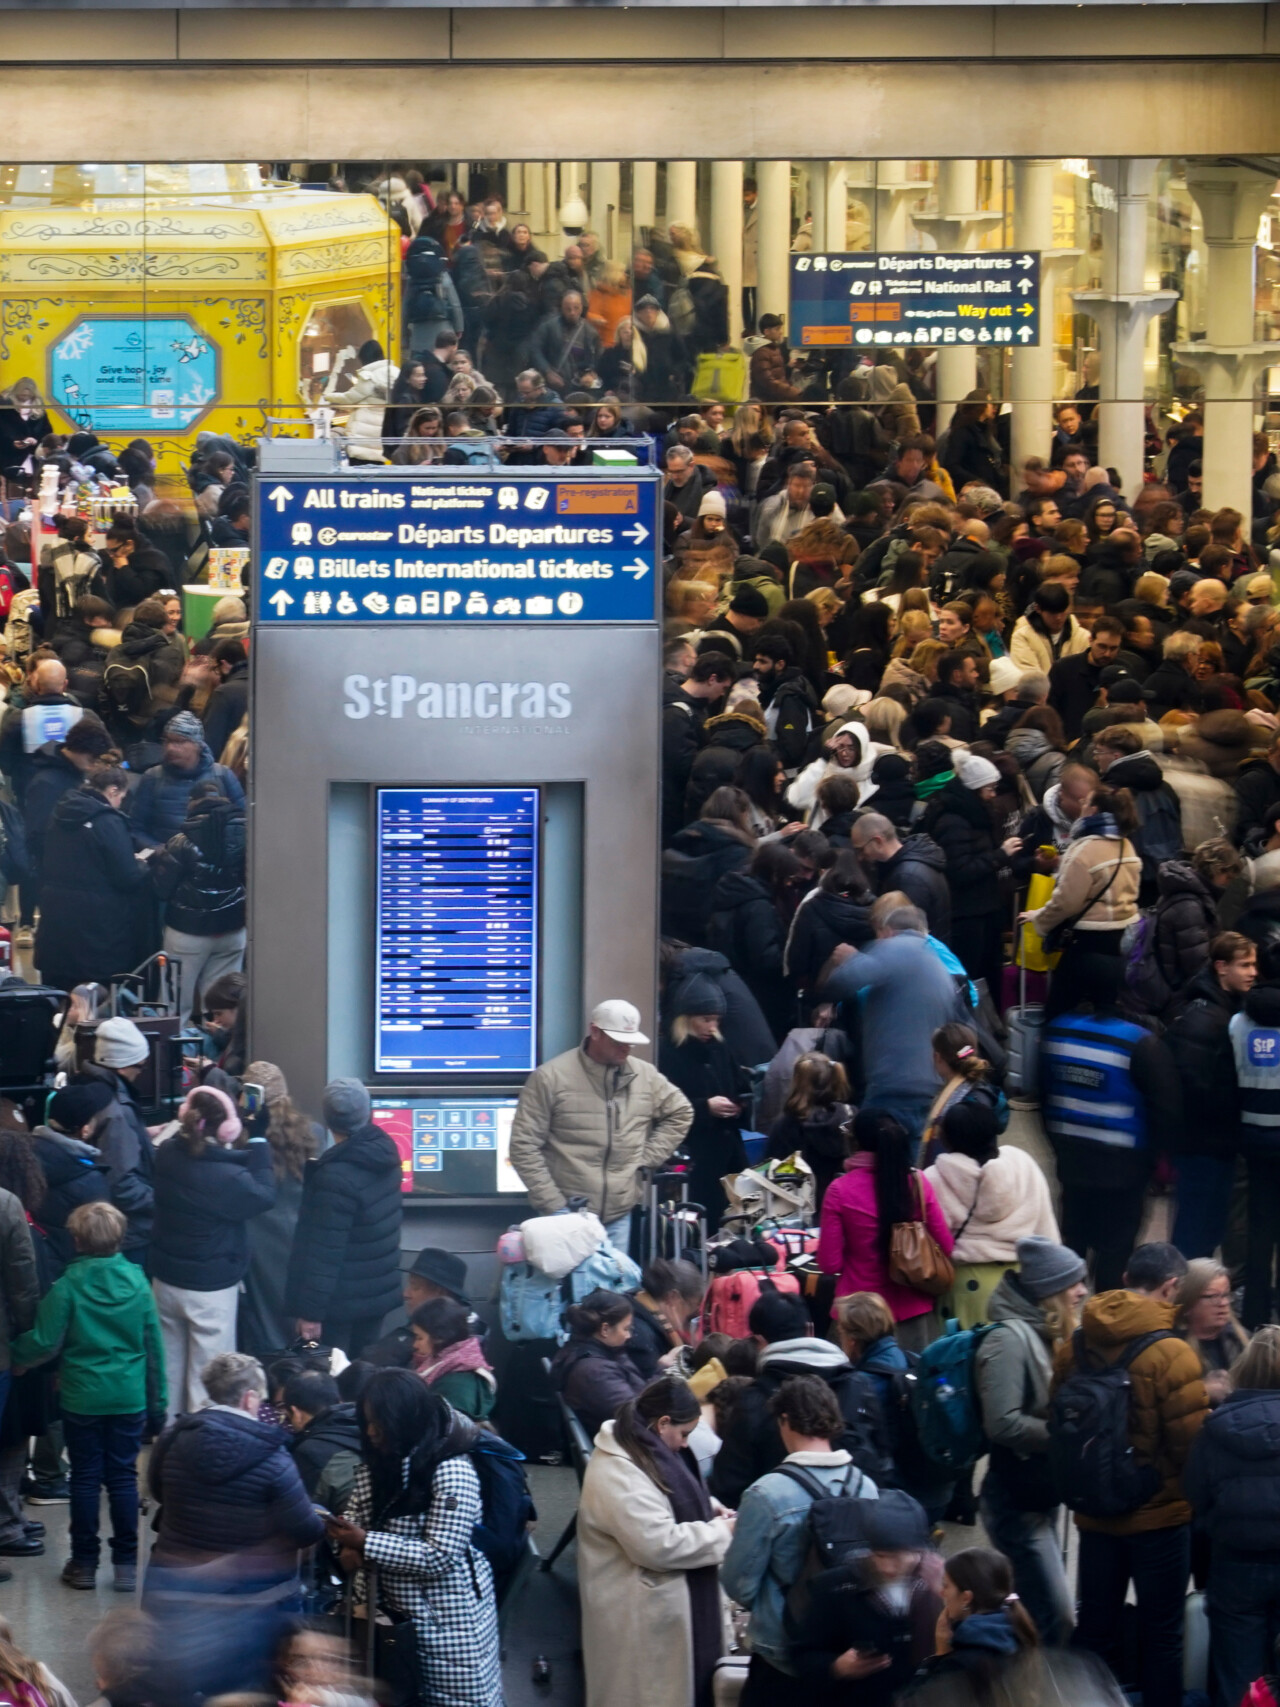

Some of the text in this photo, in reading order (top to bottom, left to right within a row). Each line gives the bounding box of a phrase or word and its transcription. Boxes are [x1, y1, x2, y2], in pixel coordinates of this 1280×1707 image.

[878, 257, 1012, 272] Départs Departures
[924, 281, 1012, 293] National Rail
[958, 305, 1012, 319] Way out
[100, 365, 123, 374] Give
[153, 364, 167, 376] joy
[96, 376, 115, 384] and
[117, 376, 145, 385] famil
[411, 486, 493, 496] National tickets
[560, 487, 636, 498] Pre-registration
[304, 489, 406, 508] All trains
[411, 498, 484, 510] and platforms
[625, 499, 635, 510] A
[338, 531, 393, 541] eurostar
[398, 523, 613, 547] Départs Departures
[319, 559, 613, 578] Billets International tickets
[460, 725, 571, 735] INTERNATIONAL
